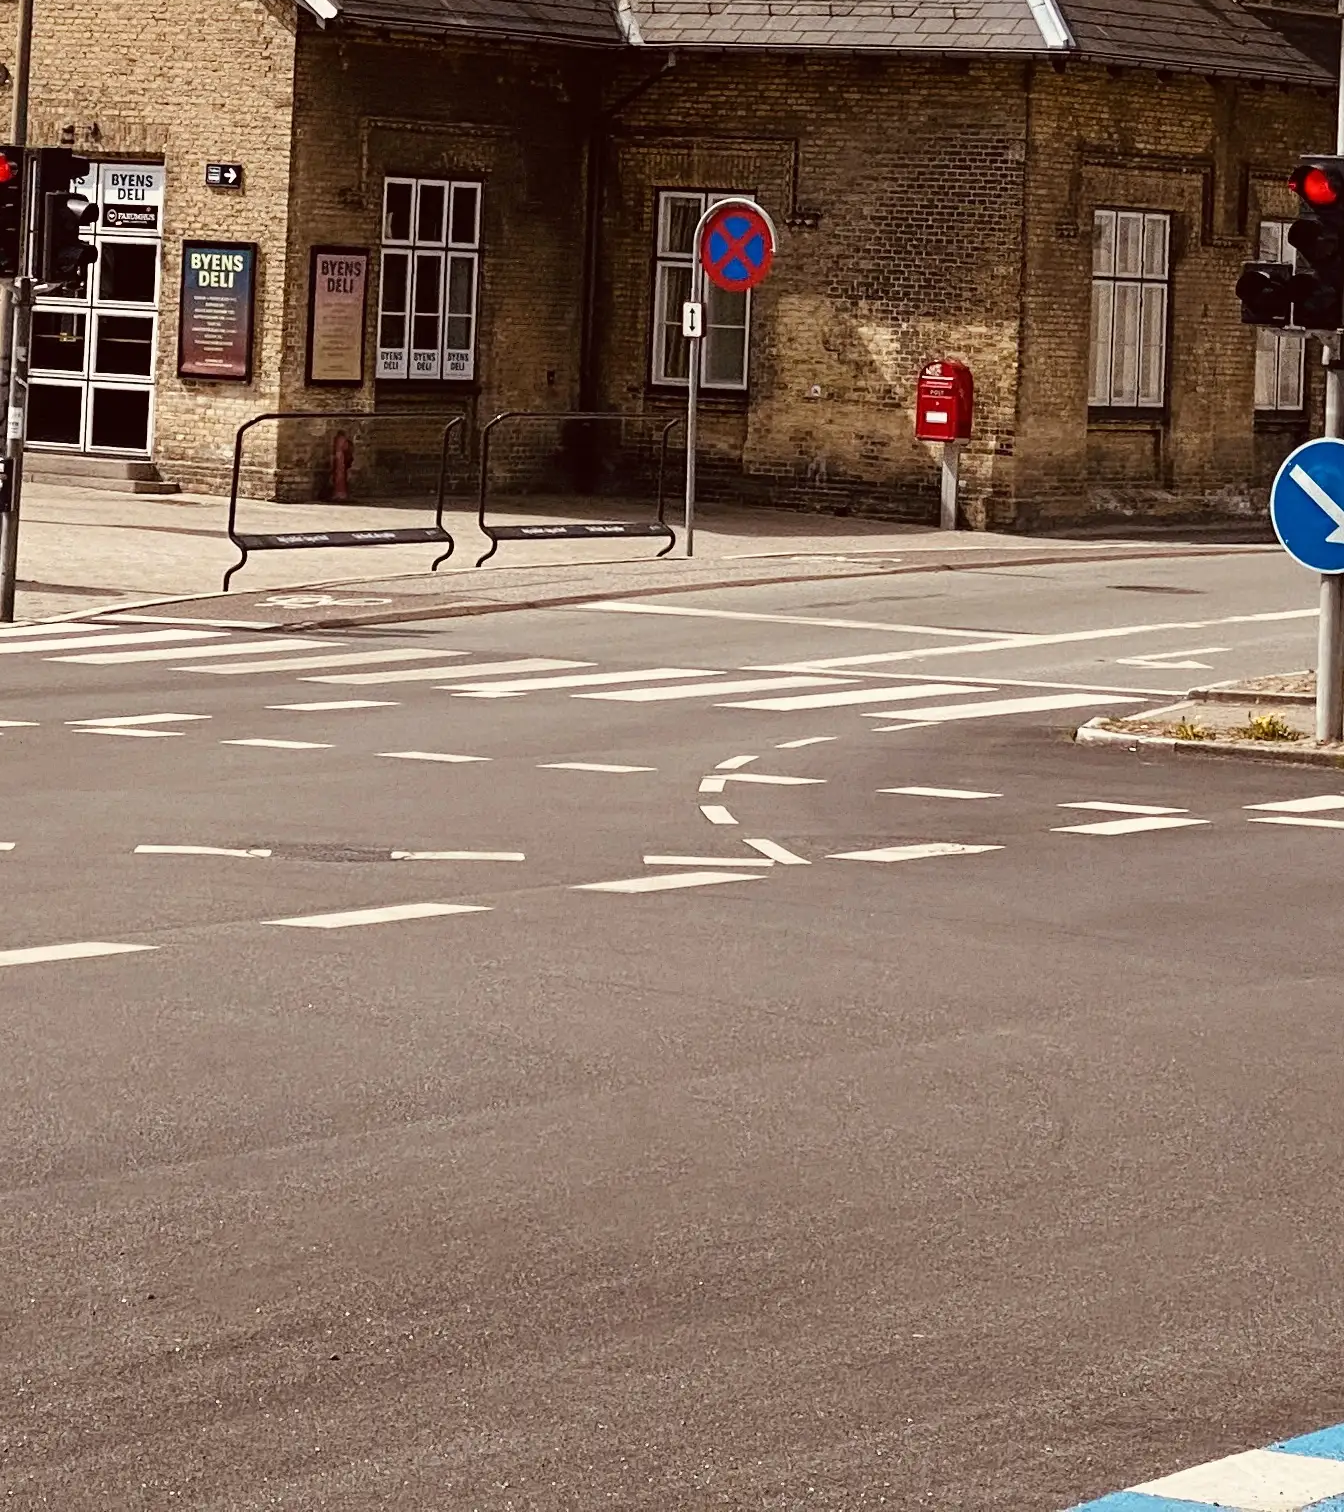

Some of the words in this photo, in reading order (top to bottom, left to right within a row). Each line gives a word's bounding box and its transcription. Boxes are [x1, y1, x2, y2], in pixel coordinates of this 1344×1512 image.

[111, 173, 154, 188] BYENS
[117, 188, 146, 201] DELI
[190, 253, 244, 273] BYENS
[321, 259, 362, 277] BYENS
[198, 270, 234, 289] DELI
[327, 277, 354, 294] DELI
[381, 351, 403, 361] BYENS
[413, 352, 436, 362] BYENS
[447, 352, 469, 362] BYENS
